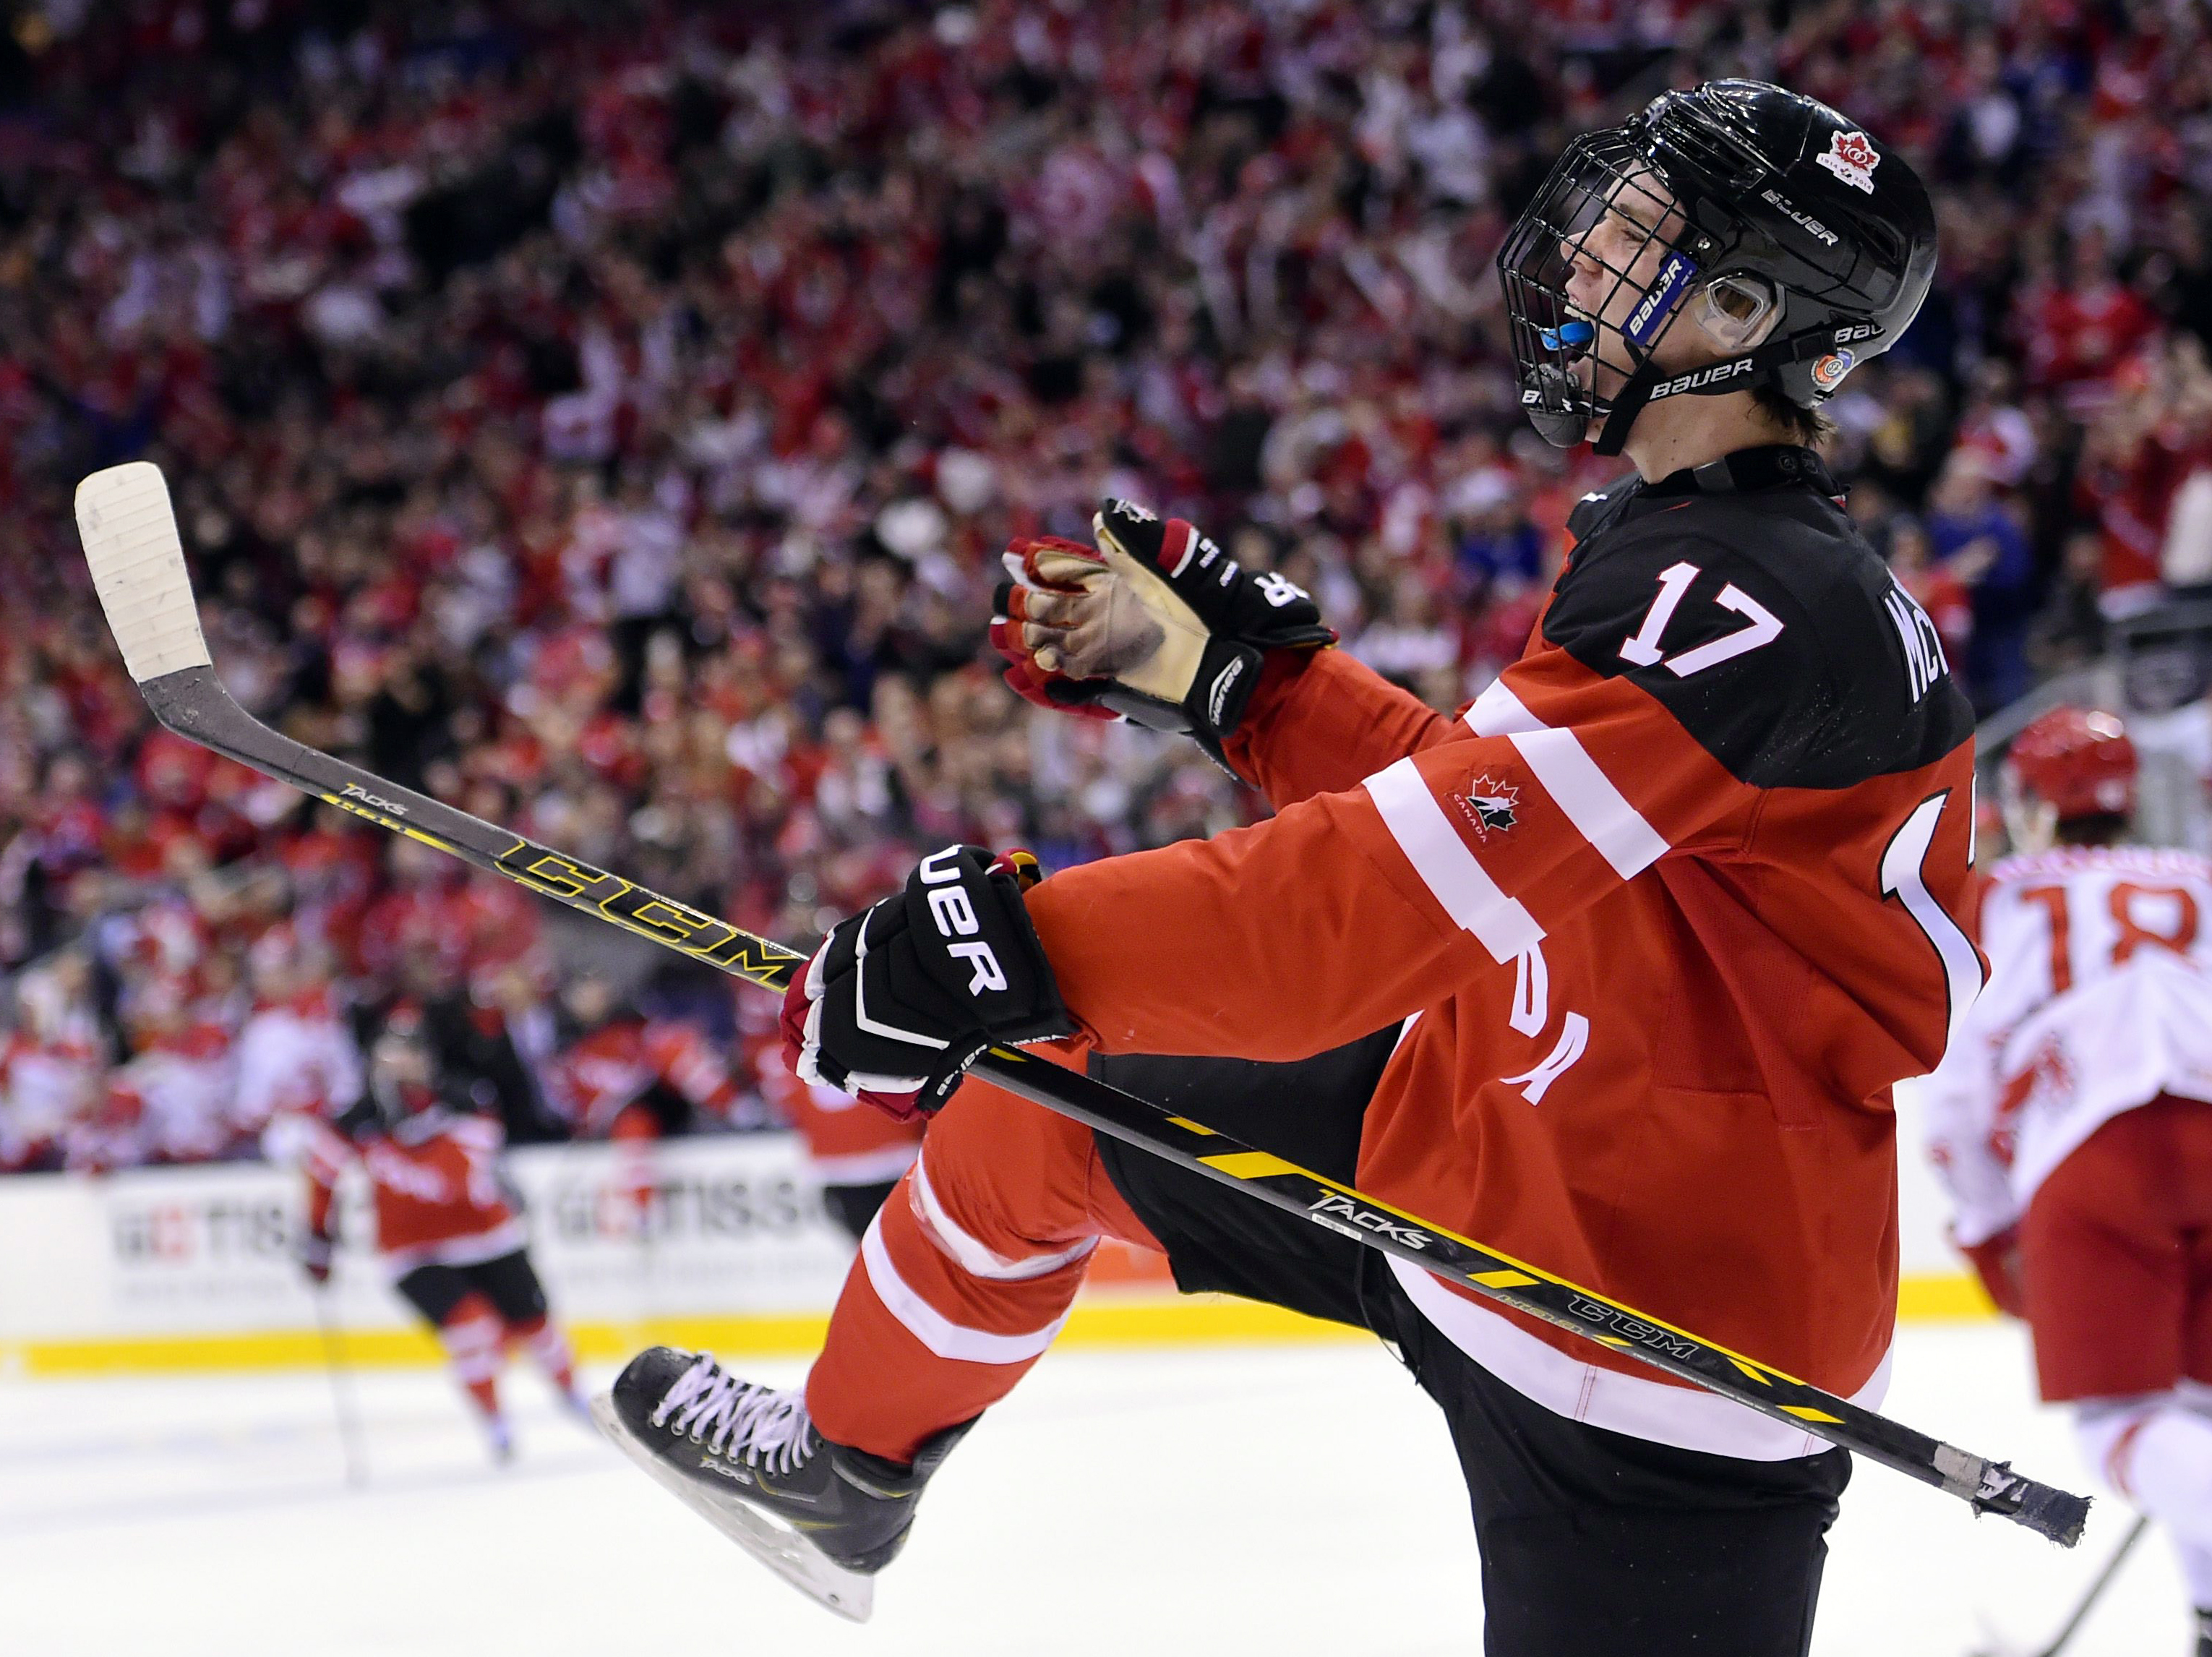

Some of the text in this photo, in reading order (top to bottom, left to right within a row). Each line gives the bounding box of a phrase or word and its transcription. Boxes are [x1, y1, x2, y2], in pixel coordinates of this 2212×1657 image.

[1629, 258, 1683, 337] BAUER
[1649, 358, 1754, 400] BAUER
[1619, 562, 1785, 677] 17
[340, 782, 408, 815] TACKS
[1454, 794, 1487, 843] CANADA
[494, 839, 799, 993] CCM
[1307, 1189, 1433, 1250] TACKS
[1567, 1294, 1699, 1359] CCM
